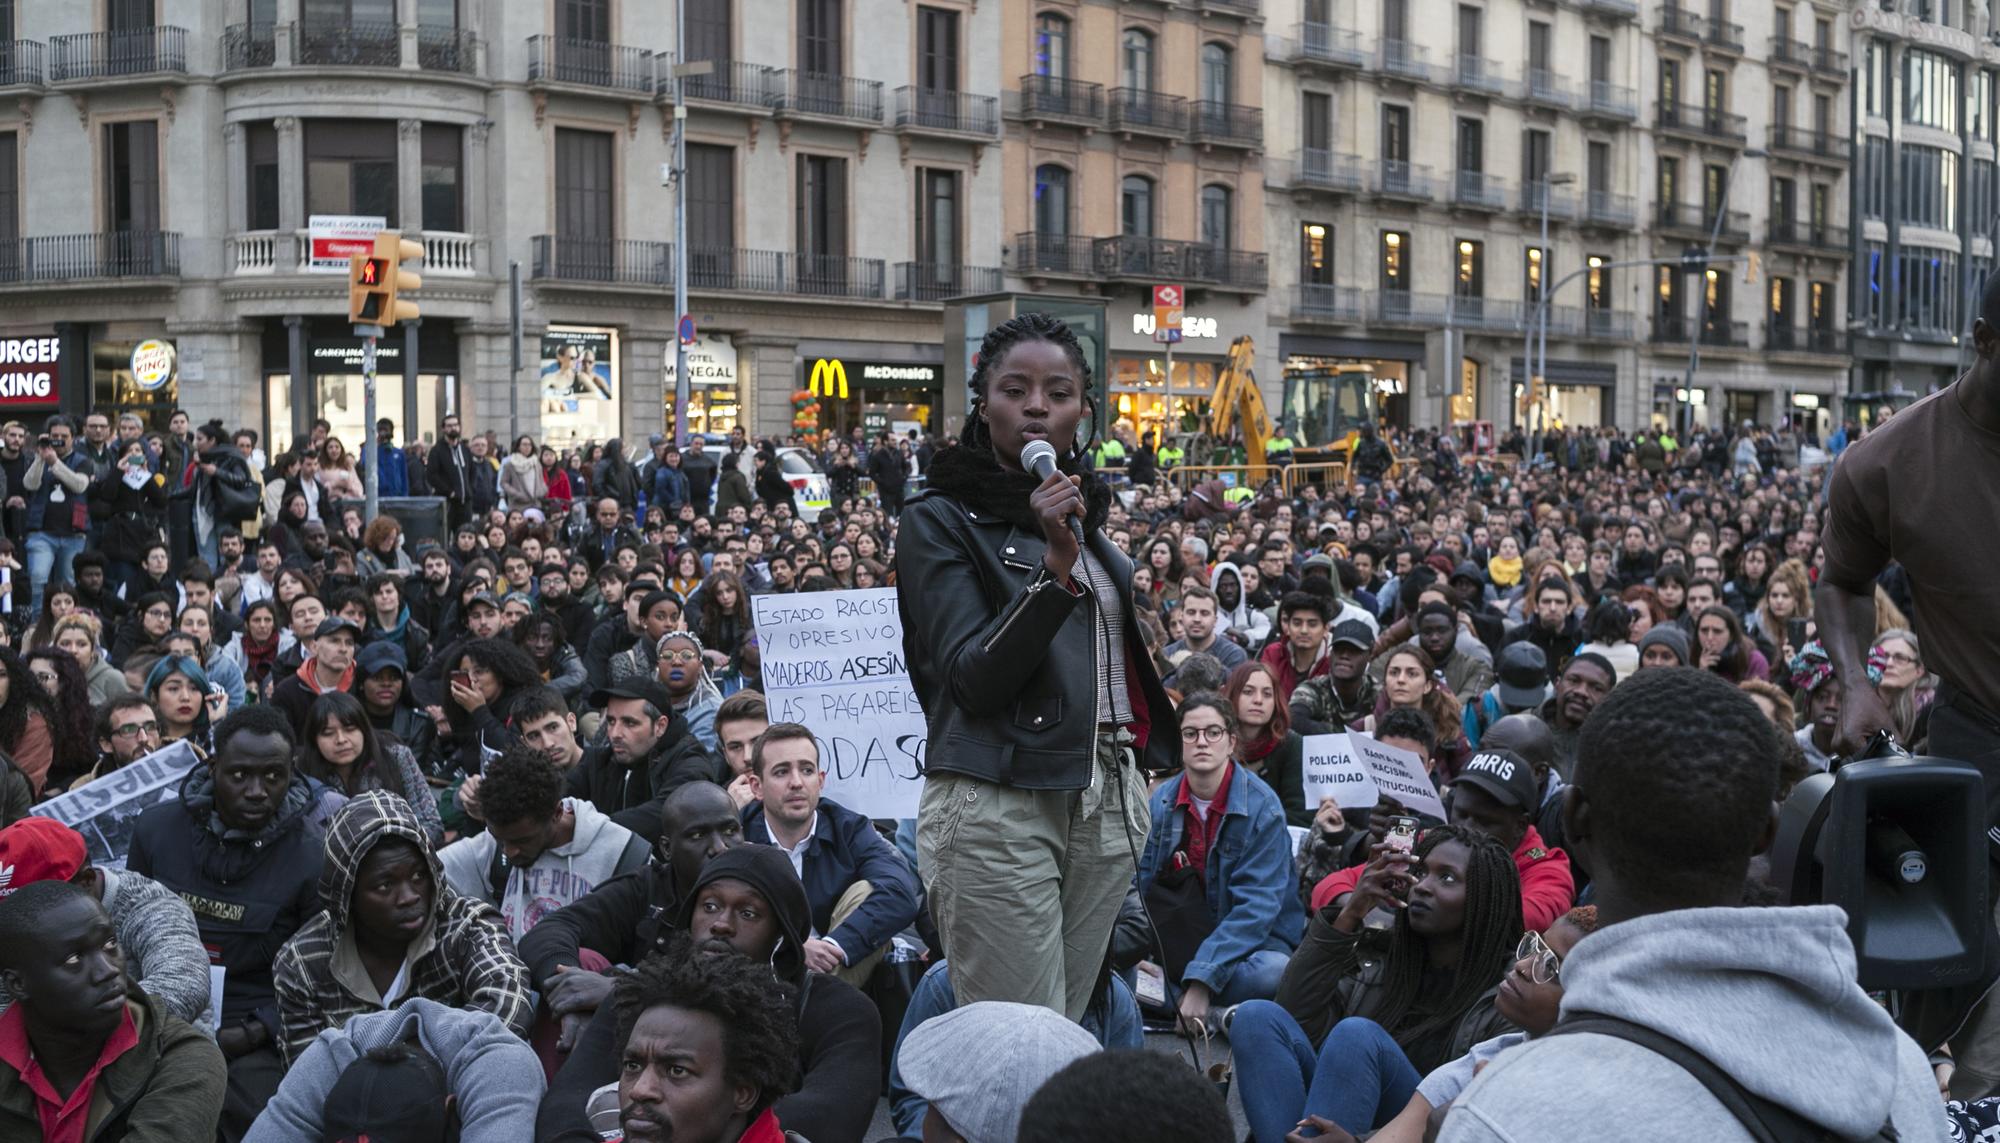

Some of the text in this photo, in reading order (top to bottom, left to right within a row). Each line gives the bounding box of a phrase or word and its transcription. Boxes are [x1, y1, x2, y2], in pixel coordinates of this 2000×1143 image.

[136, 359, 166, 375] KING
[688, 353, 715, 363] OTEL
[664, 365, 734, 378] MNEGAL
[863, 365, 934, 381] McDonald's
[757, 597, 899, 626] ESTADO RACIST
[760, 625, 896, 654] Y OPRESIVO
[763, 651, 908, 688] MADEROS ASESIN
[1309, 753, 1351, 766] POLICÍA
[1467, 752, 1516, 782] PARIS
[1370, 776, 1436, 800] STITUCIONAL
